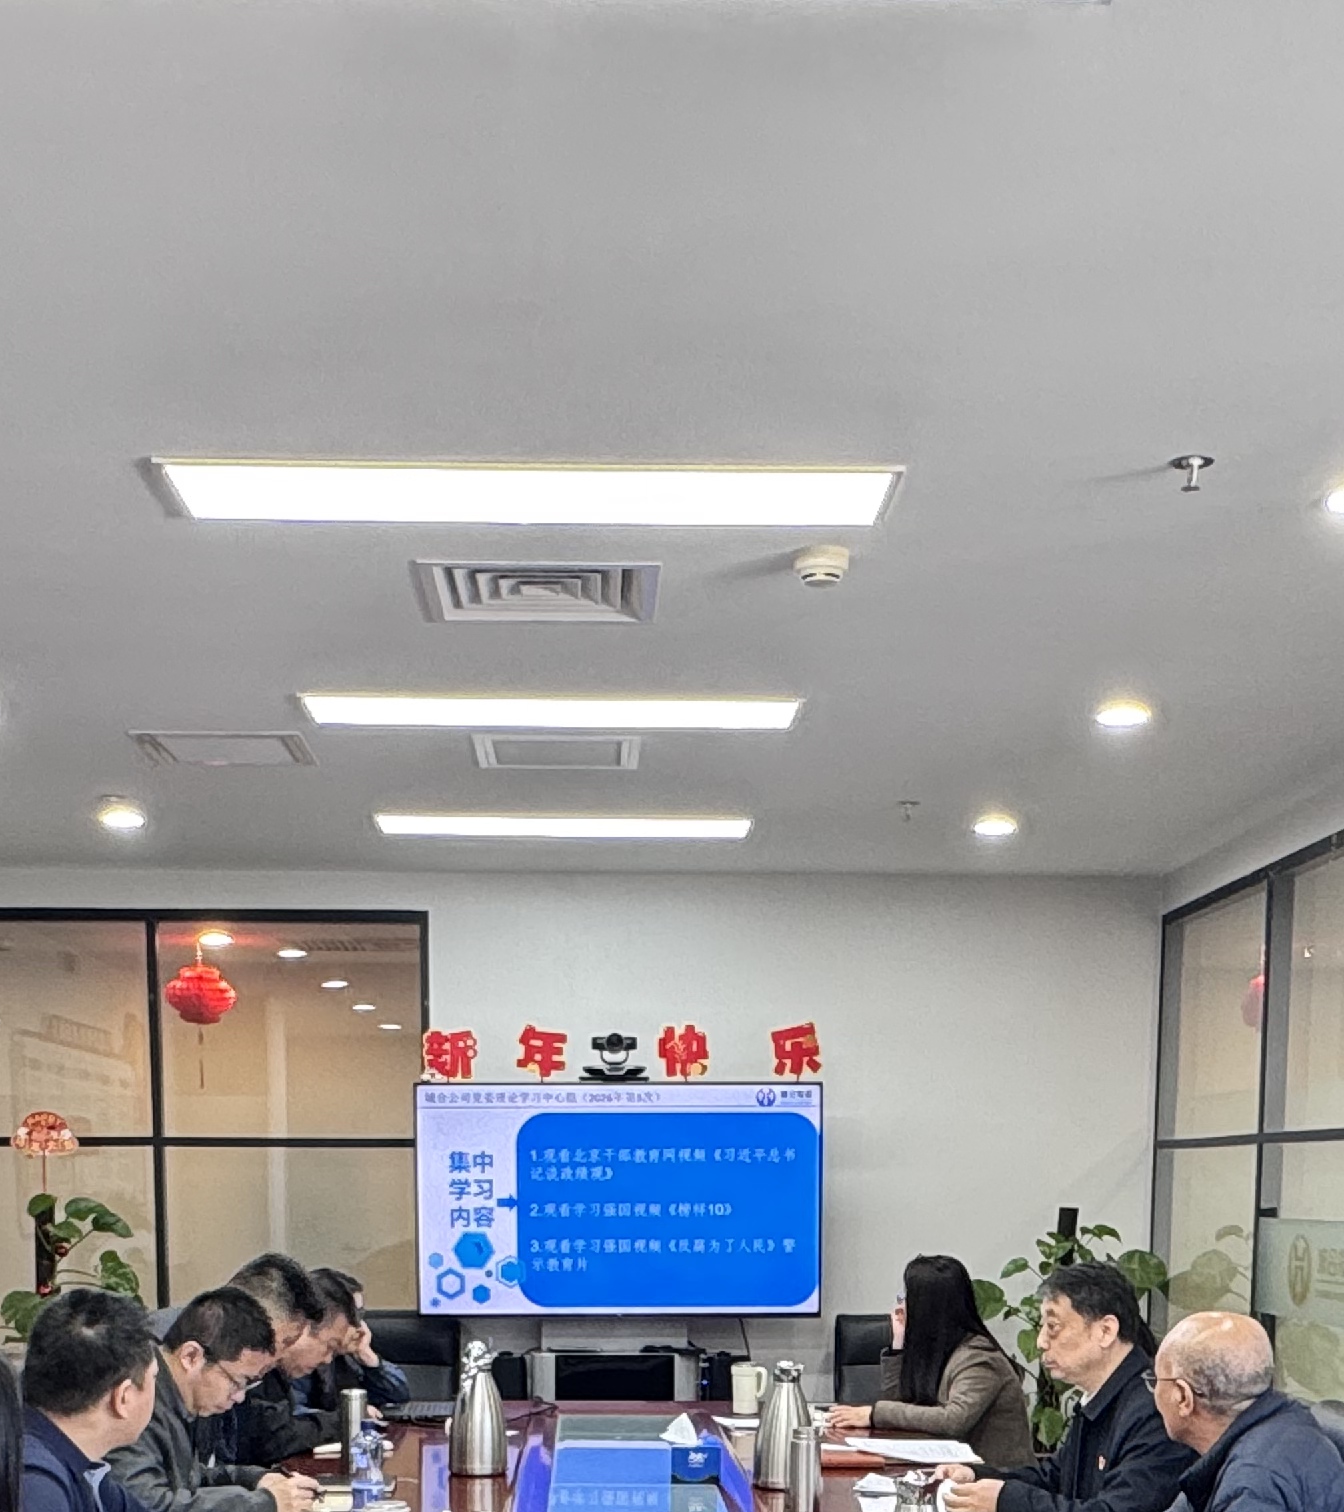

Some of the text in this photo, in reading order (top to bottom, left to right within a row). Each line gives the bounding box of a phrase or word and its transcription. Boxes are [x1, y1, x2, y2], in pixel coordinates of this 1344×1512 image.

[423, 1023, 822, 1079] 新年快乐
[448, 1150, 494, 1174] 集中
[448, 1178, 494, 1202] 学习
[449, 1205, 496, 1229] 内容
